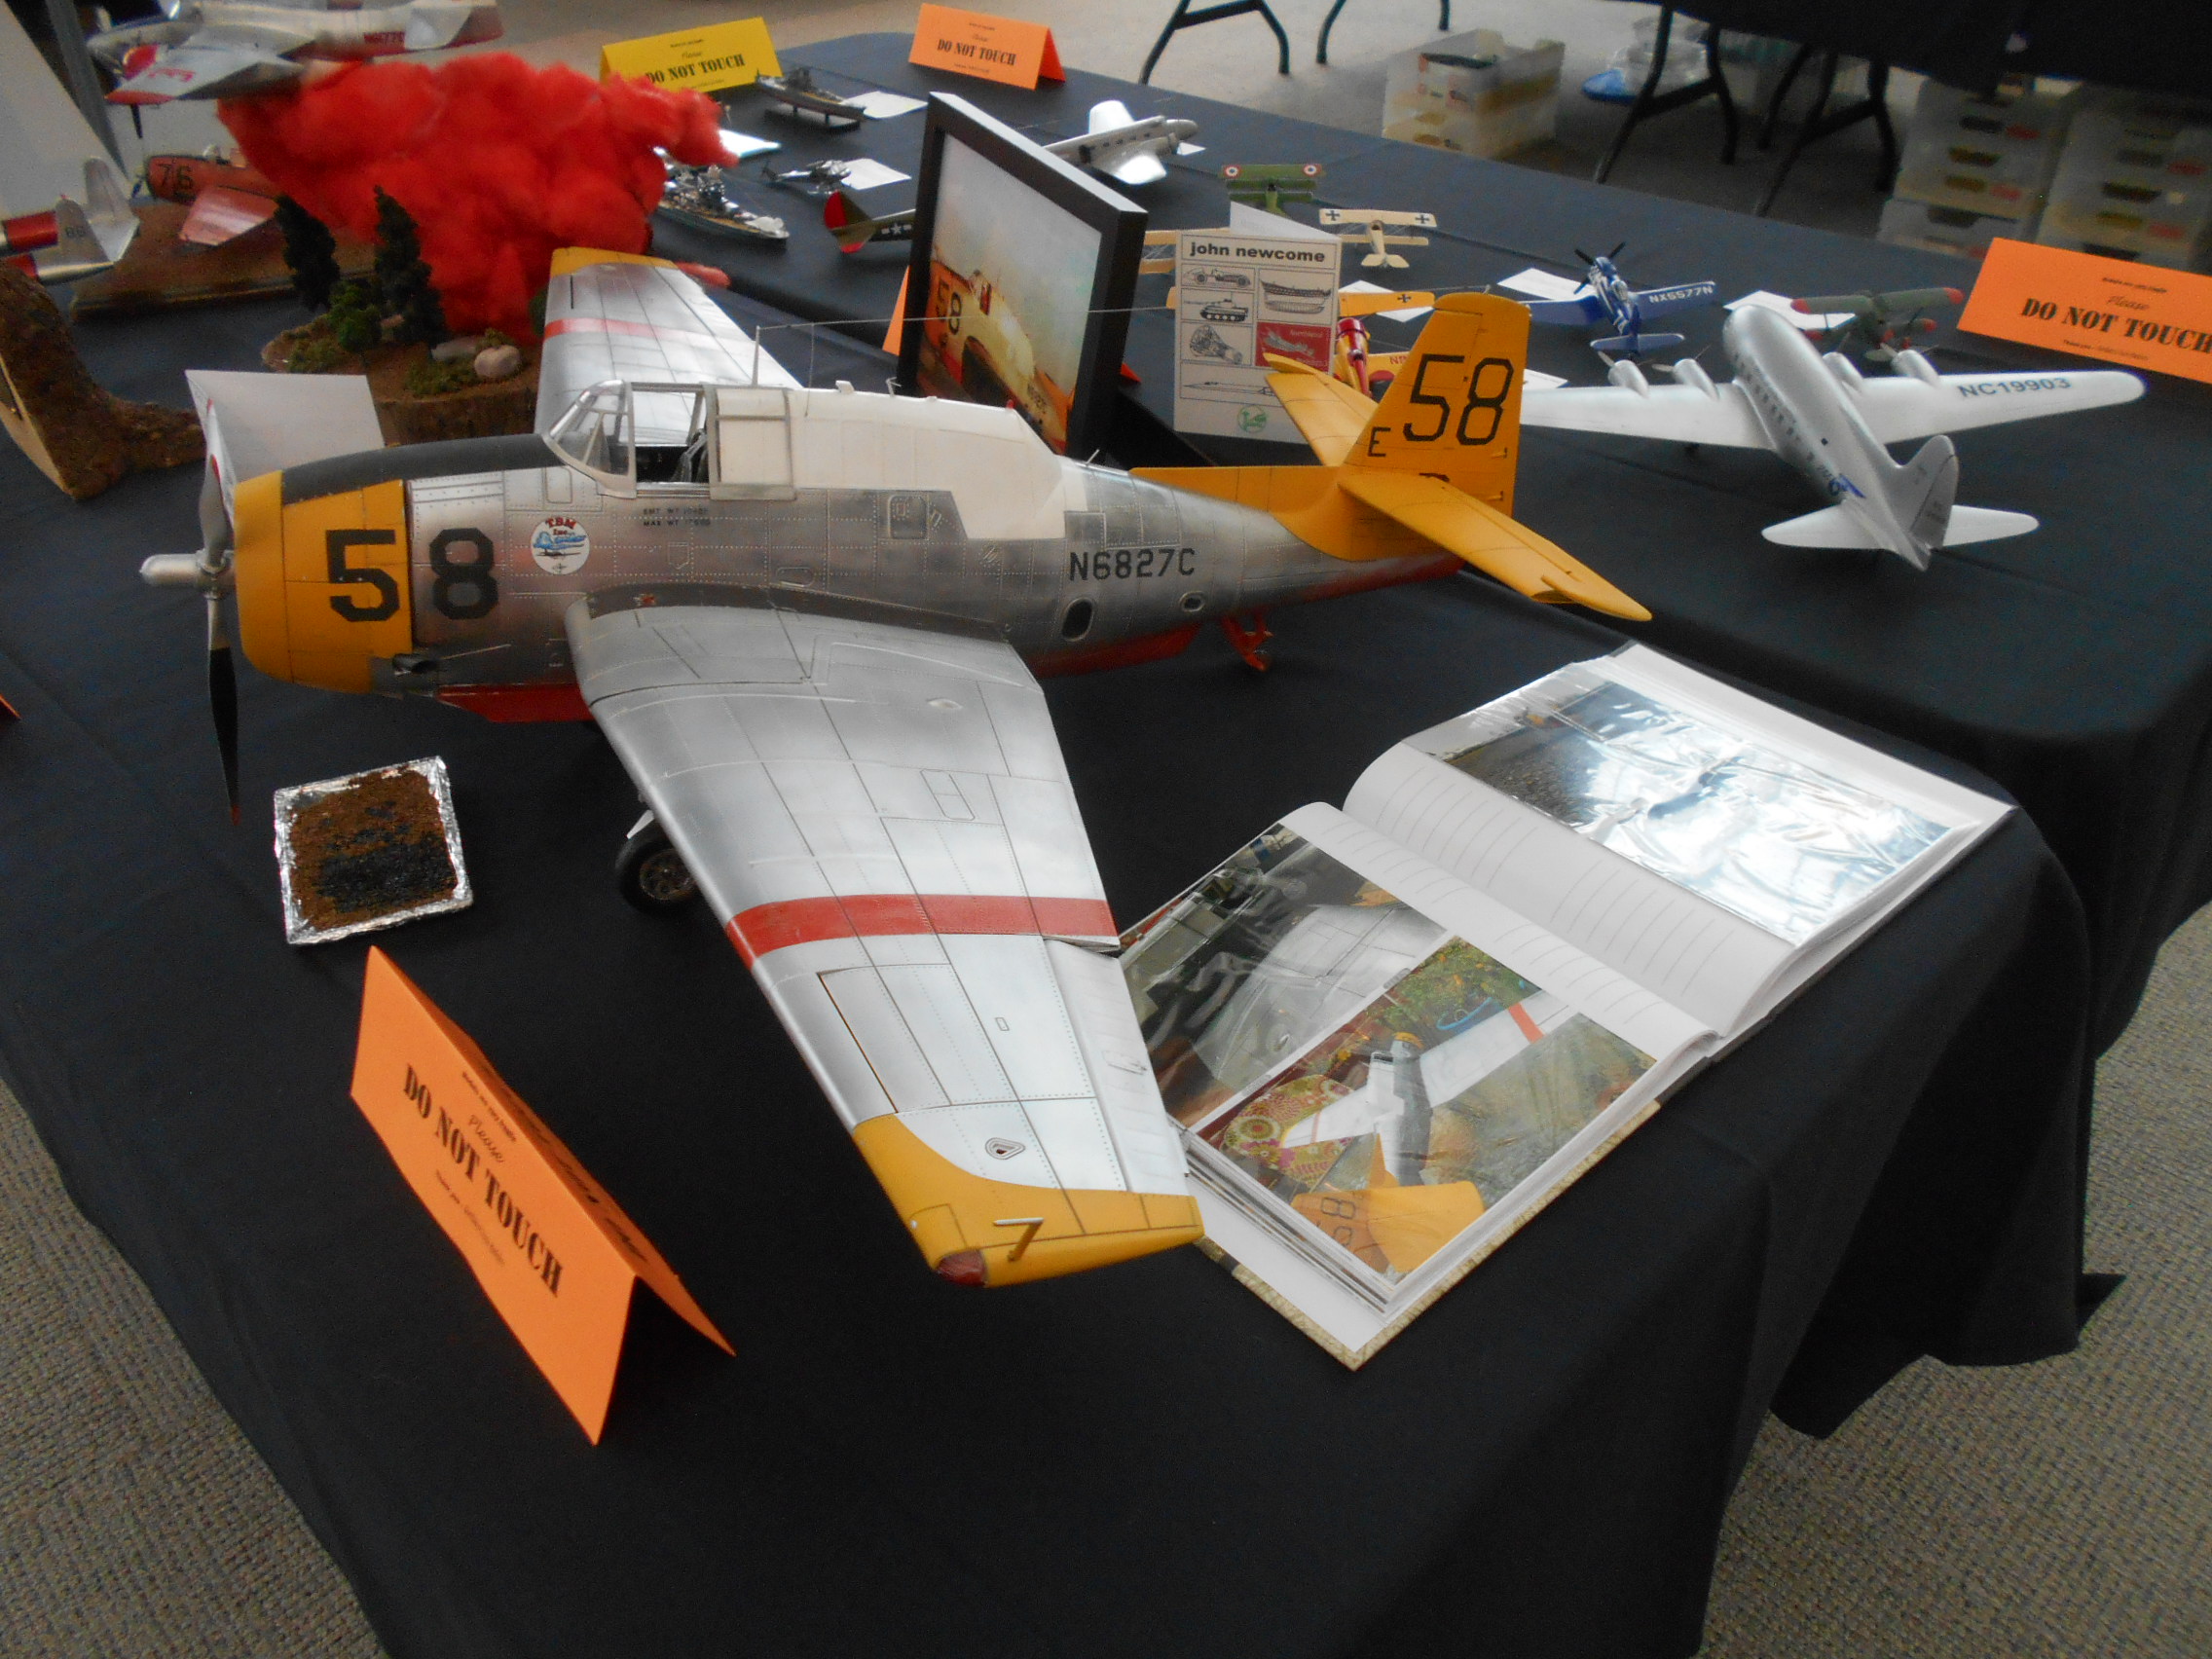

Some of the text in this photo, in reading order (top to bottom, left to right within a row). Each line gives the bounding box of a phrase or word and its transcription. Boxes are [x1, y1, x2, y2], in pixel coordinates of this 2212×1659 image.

[937, 39, 1017, 66] DO NOT TOUCH
[645, 54, 746, 84] DO NOT TOUCH
[1190, 241, 1325, 263] john newcome
[2021, 298, 2058, 320] DO
[2061, 306, 2119, 333] NOT
[2123, 317, 2212, 354] TOUCH
[1403, 353, 1515, 446] 58
[1956, 377, 2072, 397] NC19903
[1368, 426, 1392, 458] E
[544, 516, 577, 531] TBM
[1069, 547, 1196, 581] N6827C
[403, 1062, 432, 1119] DO
[434, 1105, 481, 1184] NOT
[484, 1167, 563, 1299] TOUCH
